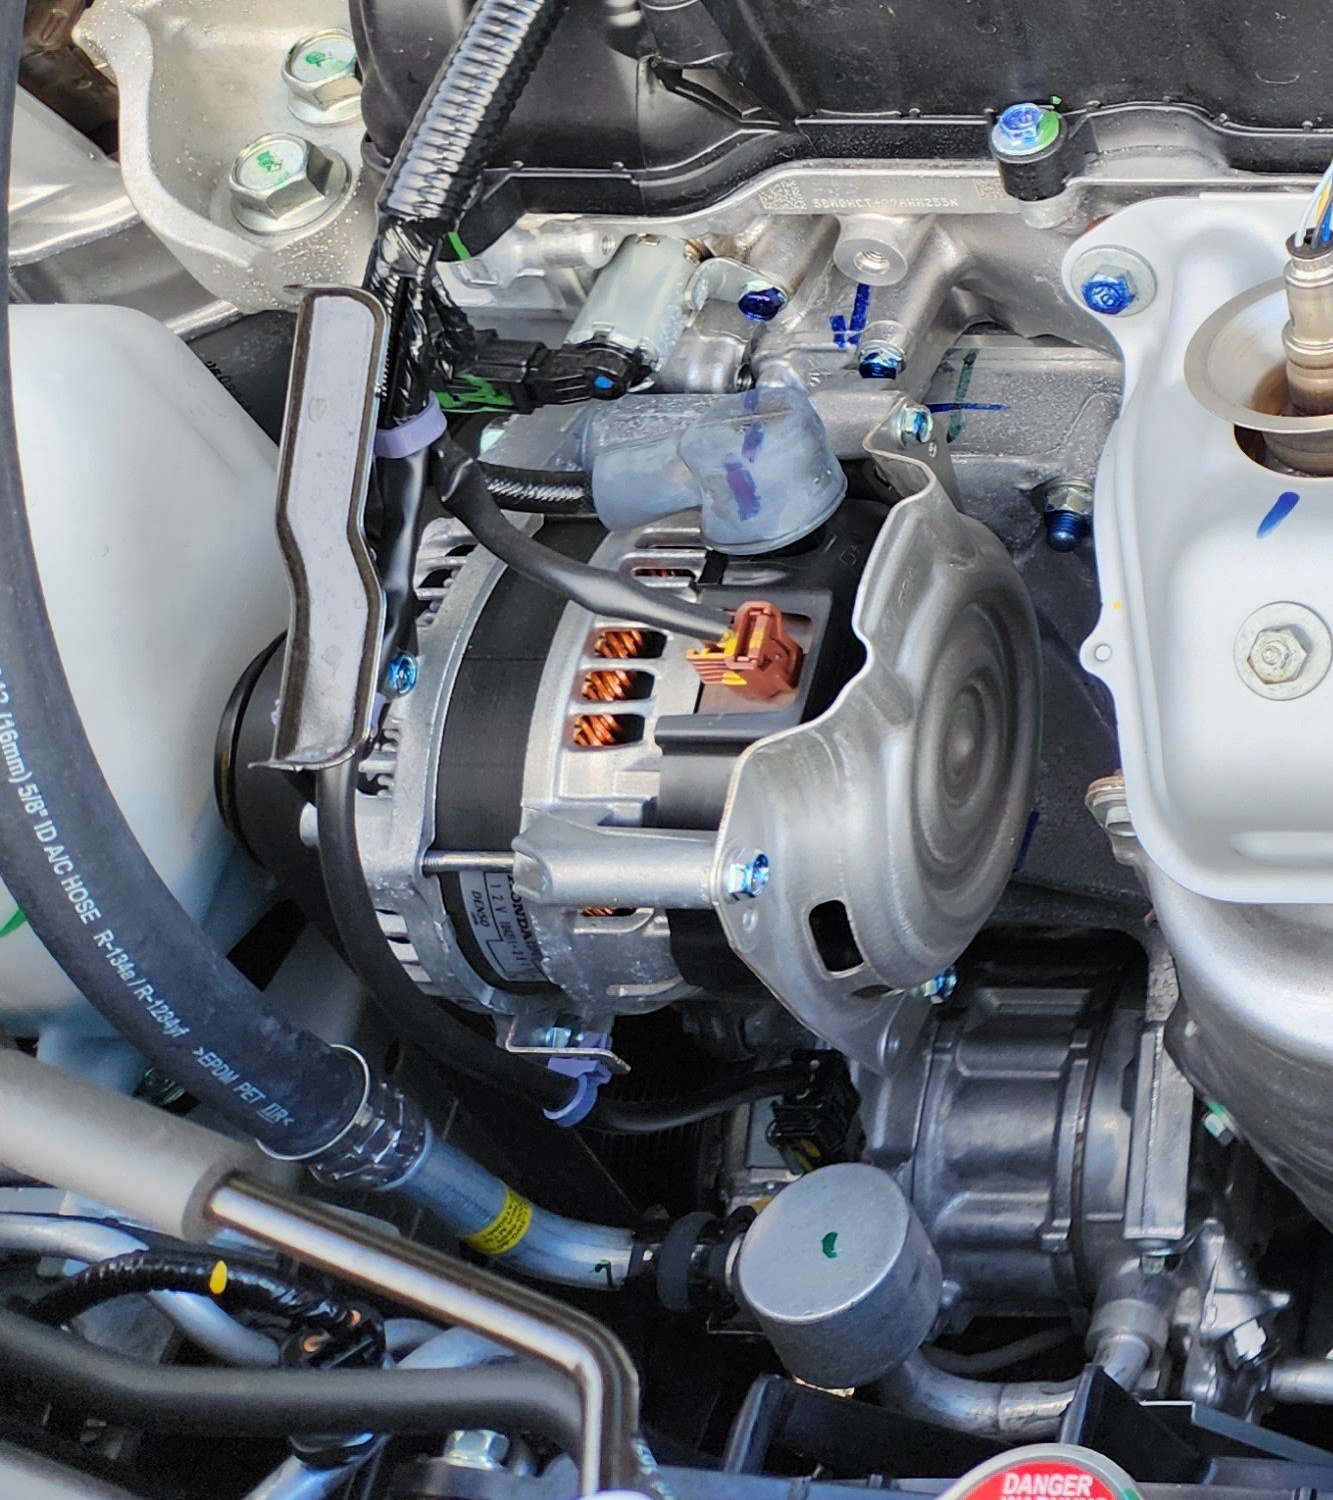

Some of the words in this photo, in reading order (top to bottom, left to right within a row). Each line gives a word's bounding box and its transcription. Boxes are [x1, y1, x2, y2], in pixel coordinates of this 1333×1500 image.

[18, 783, 48, 820] 5/8"
[33, 821, 58, 844] ID
[43, 841, 74, 876] A/C
[61, 873, 103, 926] HOSE
[471, 889, 490, 928] DENSO
[93, 928, 137, 982] R-134a
[133, 983, 192, 1039] R-1234yf
[233, 1080, 266, 1105] PET
[1001, 1473, 1094, 1496] DANGER
